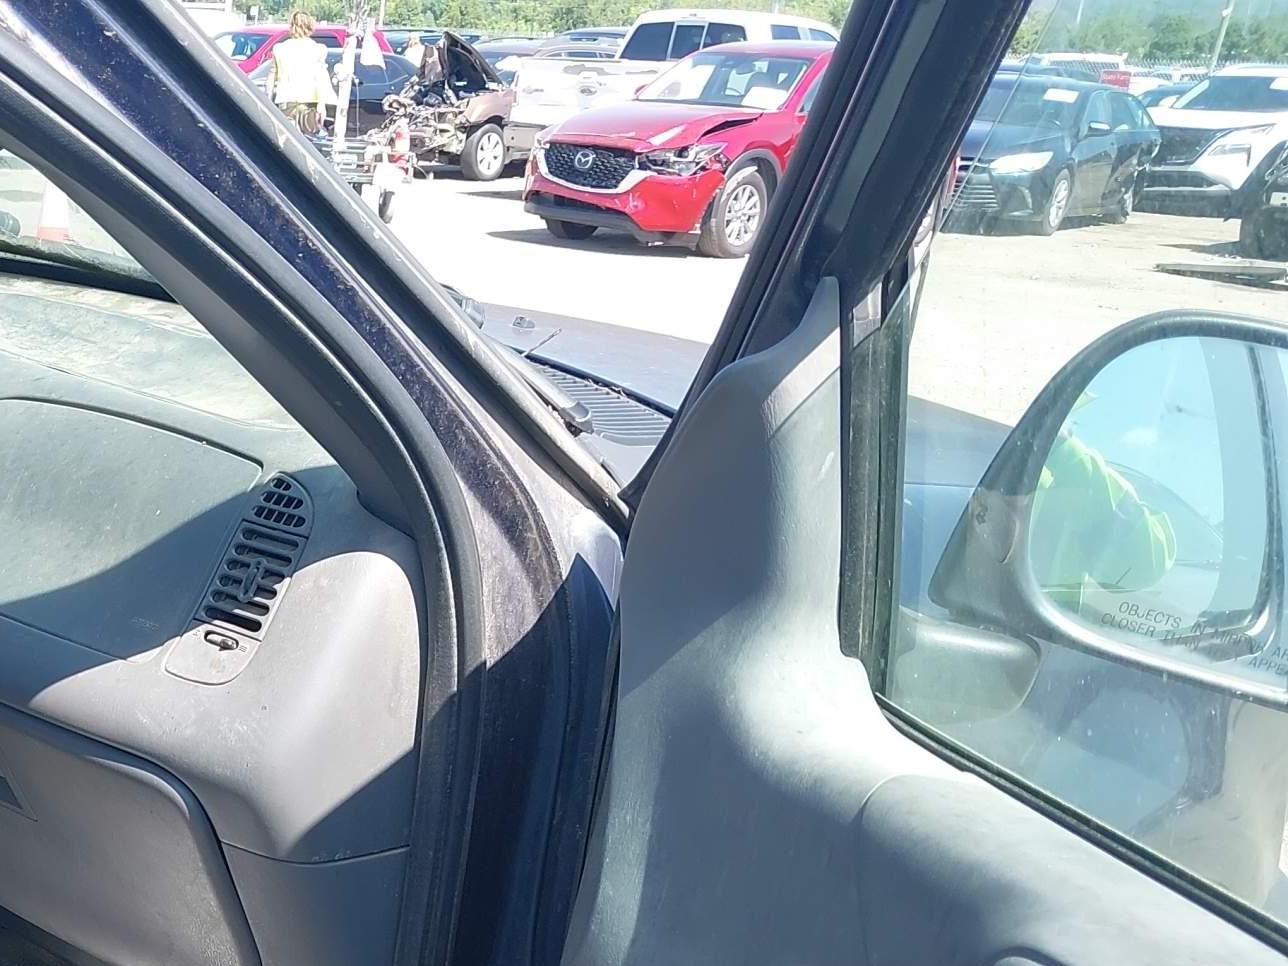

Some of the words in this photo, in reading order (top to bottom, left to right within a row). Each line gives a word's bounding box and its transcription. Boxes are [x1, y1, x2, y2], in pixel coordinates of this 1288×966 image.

[1101, 612, 1156, 638] CLOSER
[1118, 601, 1182, 629] OBJECTS
[1190, 619, 1208, 636] IN
